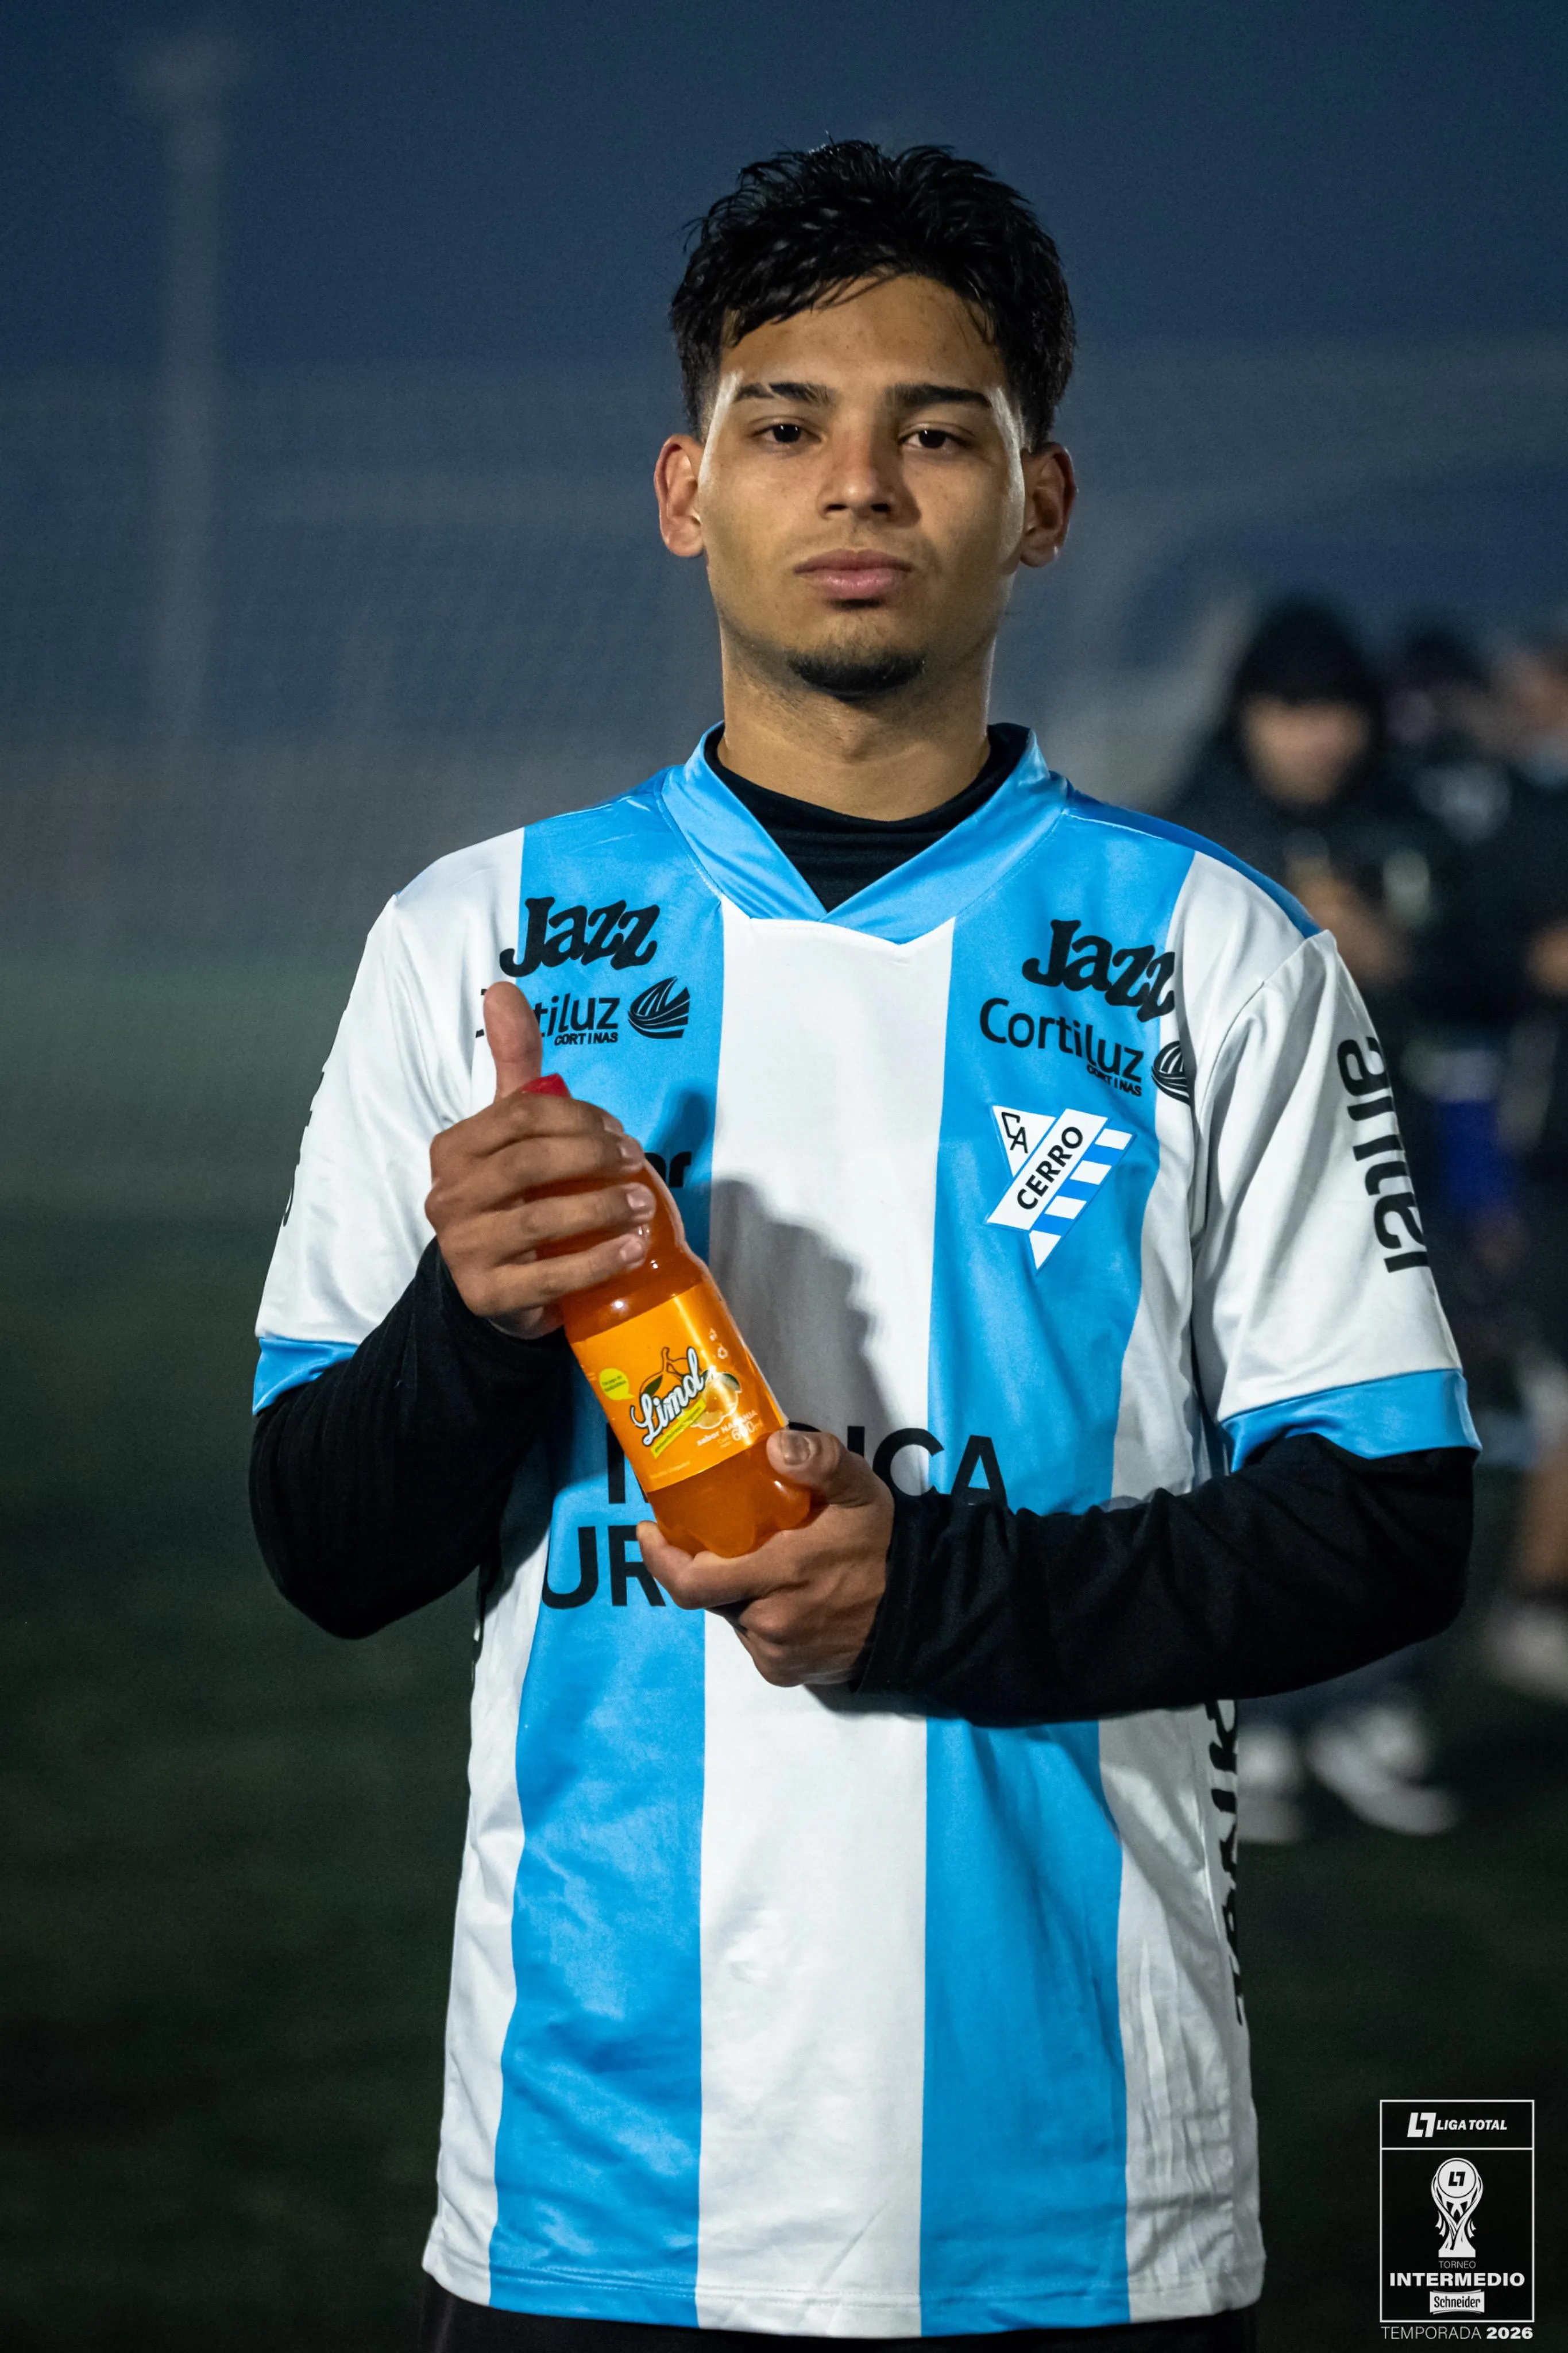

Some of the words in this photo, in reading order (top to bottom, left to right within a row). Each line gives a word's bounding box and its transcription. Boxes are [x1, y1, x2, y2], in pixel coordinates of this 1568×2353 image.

[499, 896, 660, 977] Jazz
[1022, 919, 1175, 1023] Jazz
[554, 1032, 618, 1046] CORTINAS
[980, 997, 1144, 1083] Cortiluz
[1017, 1126, 1084, 1210] CERRO
[721, 1409, 758, 1433] NAANJA
